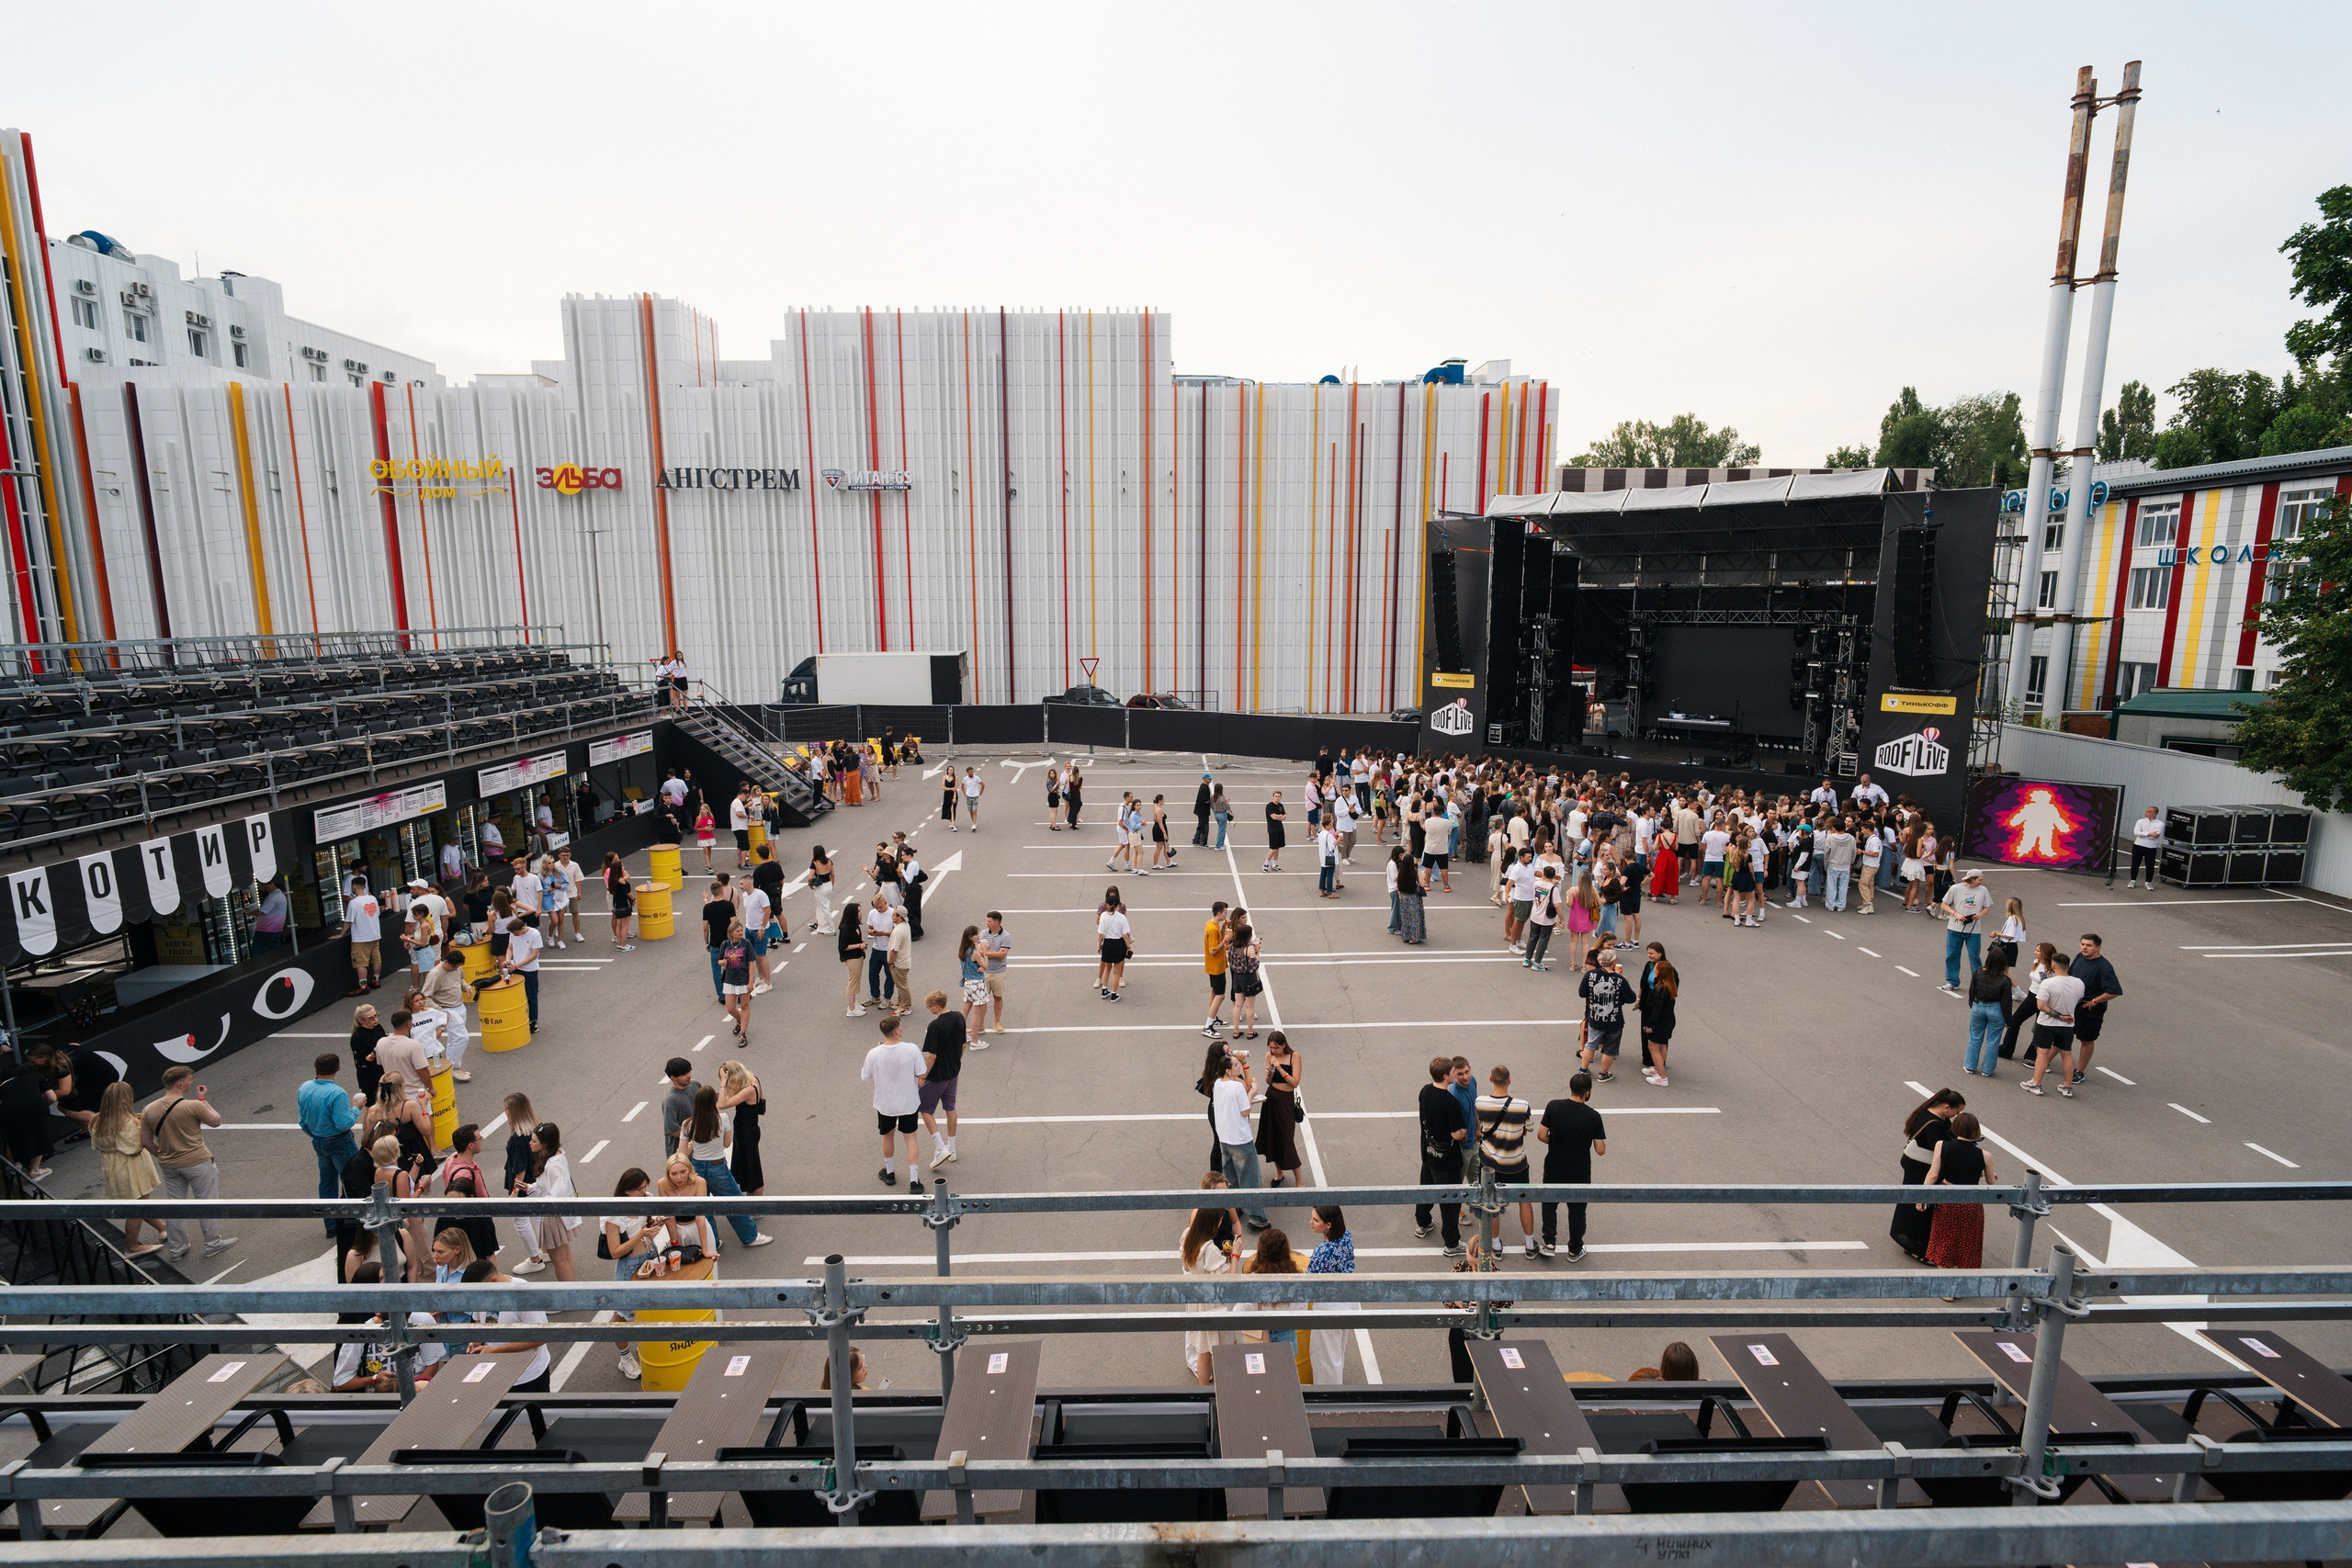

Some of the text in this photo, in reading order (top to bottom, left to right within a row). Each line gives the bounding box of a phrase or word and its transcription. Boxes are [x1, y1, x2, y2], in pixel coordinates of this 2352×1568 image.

[369, 454, 503, 479] ОБОЙНЫЙ
[846, 469, 913, 485] ТИТАН-GS
[655, 467, 801, 490] АНГСТРЕМ
[1432, 706, 1453, 730] ROOF
[1878, 739, 1913, 768] ROOF
[1589, 972, 1623, 987] MAKE
[433, 1105, 452, 1118] ндекс
